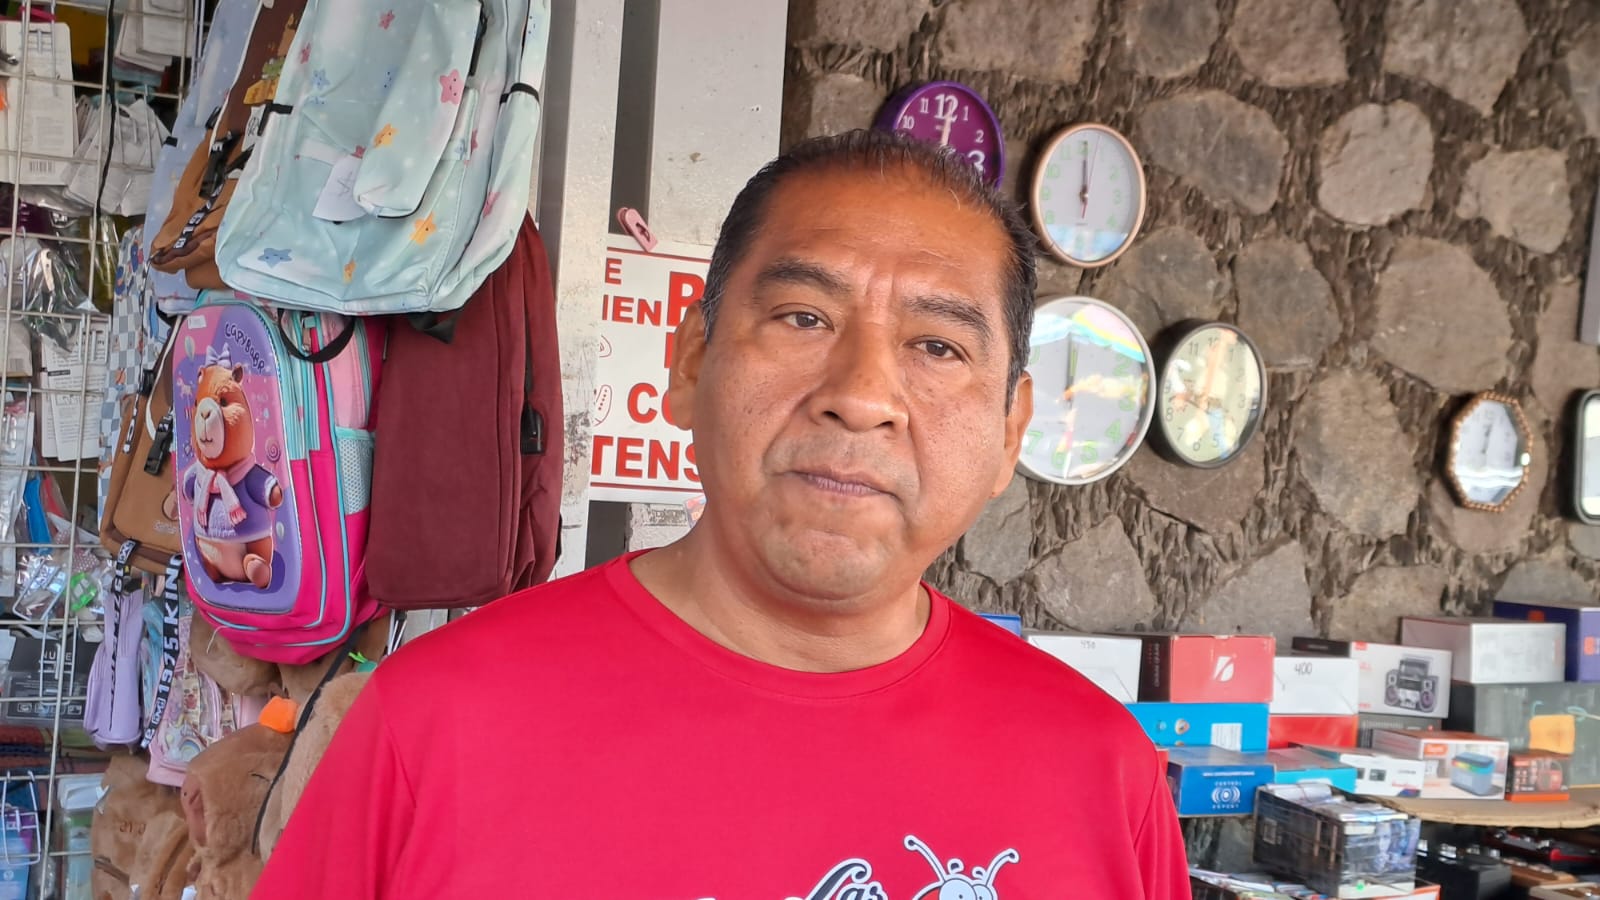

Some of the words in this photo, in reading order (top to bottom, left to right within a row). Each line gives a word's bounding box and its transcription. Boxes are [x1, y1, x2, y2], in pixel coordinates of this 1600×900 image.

[920, 97, 929, 114] 11
[934, 93, 958, 122] 12
[963, 106, 969, 121] 1
[902, 115, 915, 129] 10
[975, 130, 985, 143] 2
[1112, 353, 1132, 377] 2
[1105, 418, 1122, 443] 4
[1294, 661, 1313, 676] 400
